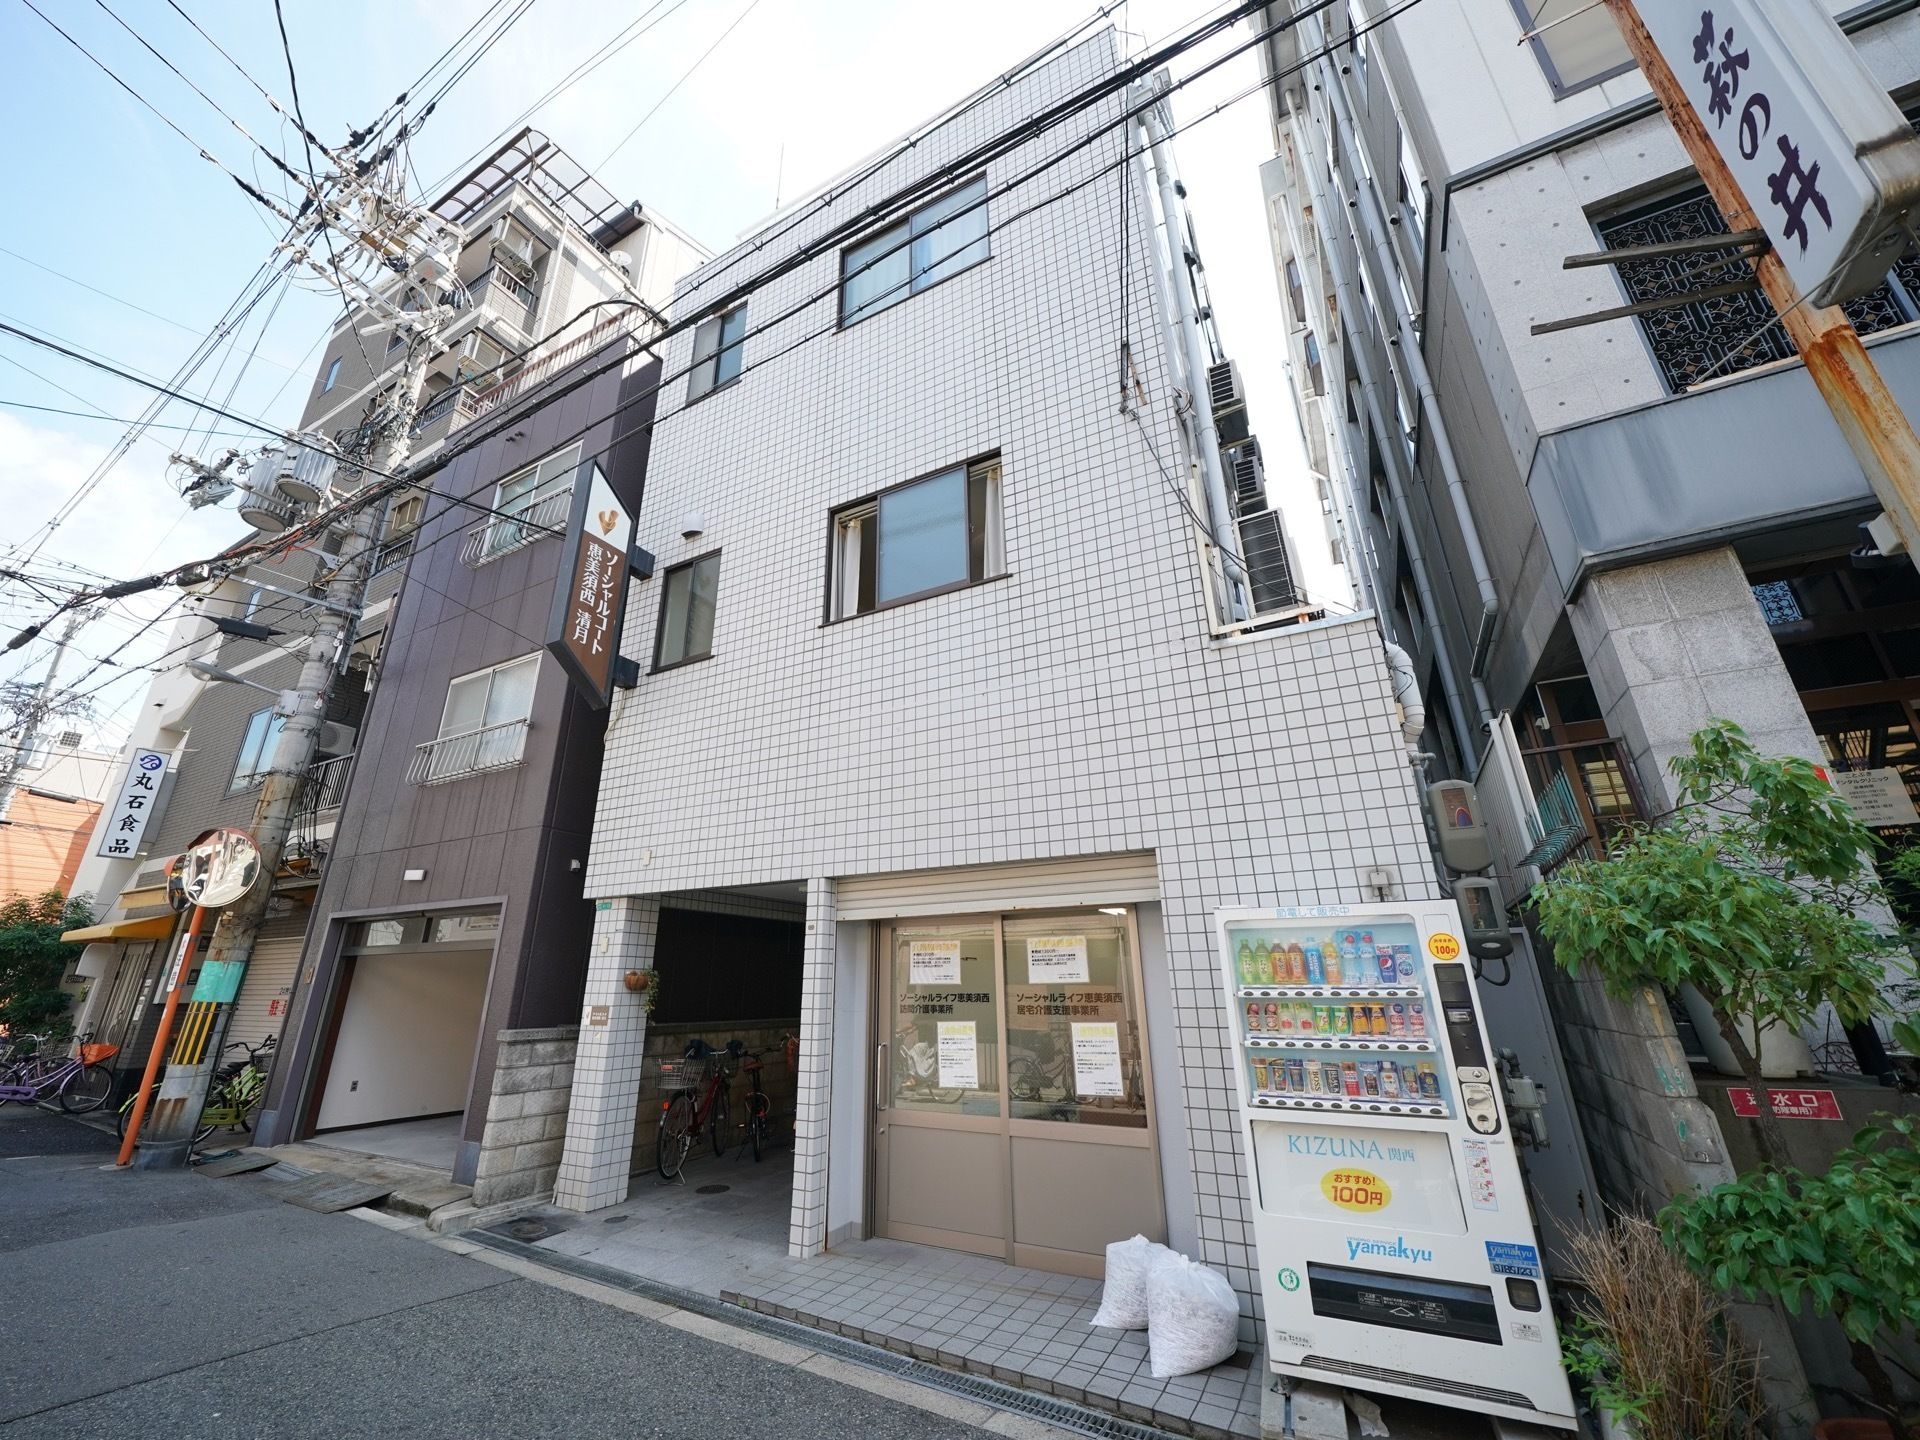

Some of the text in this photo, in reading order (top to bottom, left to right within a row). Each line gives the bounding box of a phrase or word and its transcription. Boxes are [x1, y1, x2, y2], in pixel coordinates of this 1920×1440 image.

[572, 541, 603, 645] 恵美須西 清月
[591, 550, 619, 655] ソーシャルコート
[107, 772, 154, 854] 丸石食品
[1276, 906, 1350, 918] 節電して販売中
[1435, 946, 1457, 955] 100円
[899, 993, 990, 1003] ソーシャルライフ恵美須西
[1016, 992, 1123, 1004] ソーシャルライフ恵美須西
[899, 1004, 954, 1015] 訪問介護事業所
[1017, 1004, 1100, 1016] 居宅介護支援事業所
[1311, 1070, 1322, 1092] BOSS
[1287, 1134, 1415, 1162] KIZUNA 関西
[1334, 1174, 1376, 1186] おすすめ!
[1331, 1185, 1383, 1206] 100円
[1347, 1236, 1432, 1263] yamakyu
[1490, 1245, 1533, 1258] yamakyu
